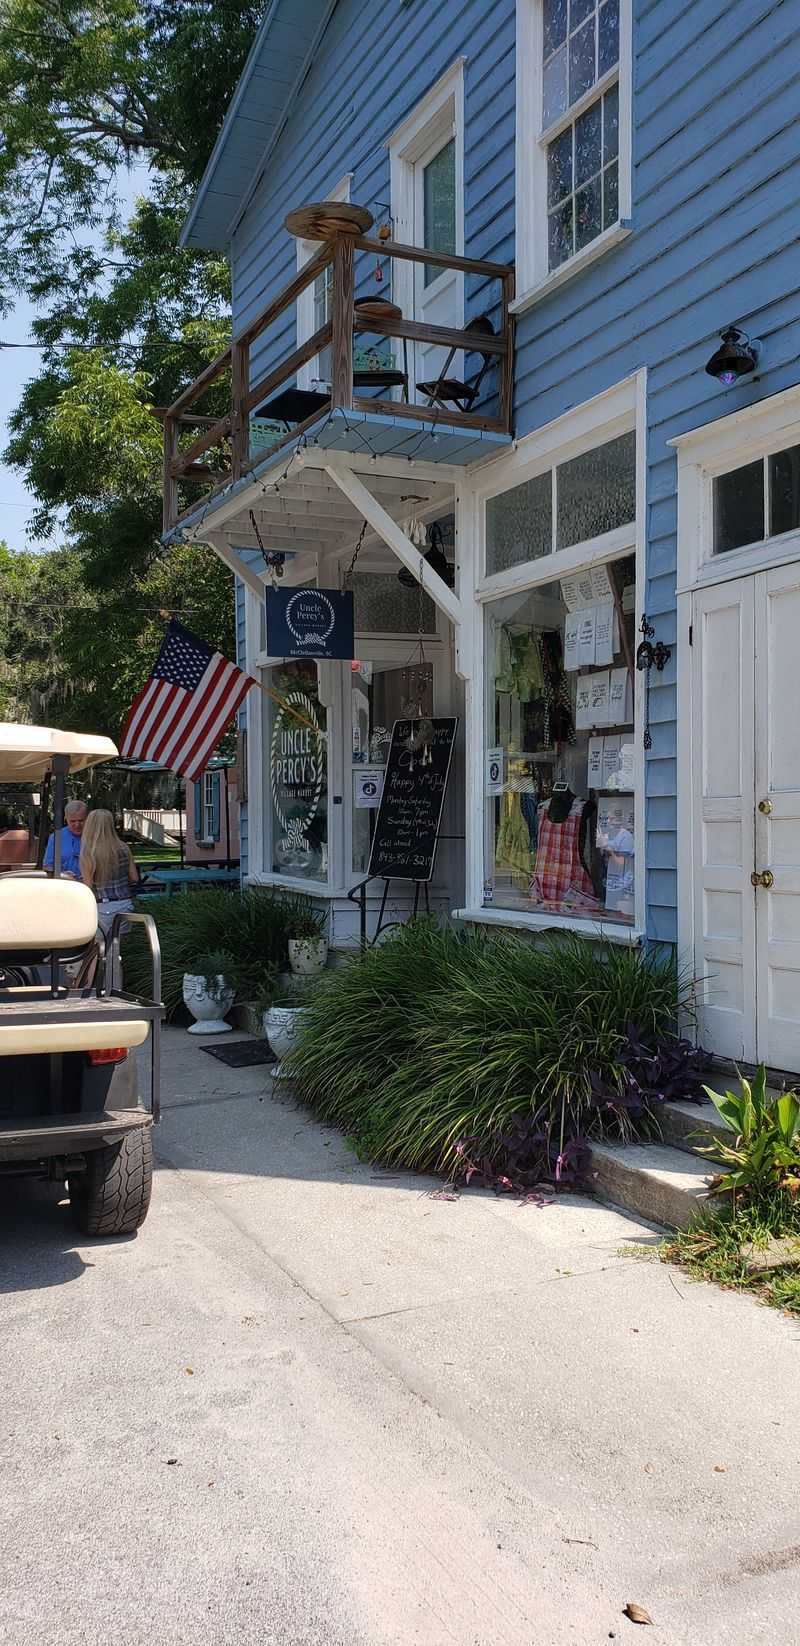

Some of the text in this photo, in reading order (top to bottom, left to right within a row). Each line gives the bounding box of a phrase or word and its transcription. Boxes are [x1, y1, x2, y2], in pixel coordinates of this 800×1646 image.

[297, 611, 325, 620] Percy's
[299, 603, 322, 612] Uncle
[281, 728, 311, 755] UNCLE
[276, 756, 317, 784] PERCY'S
